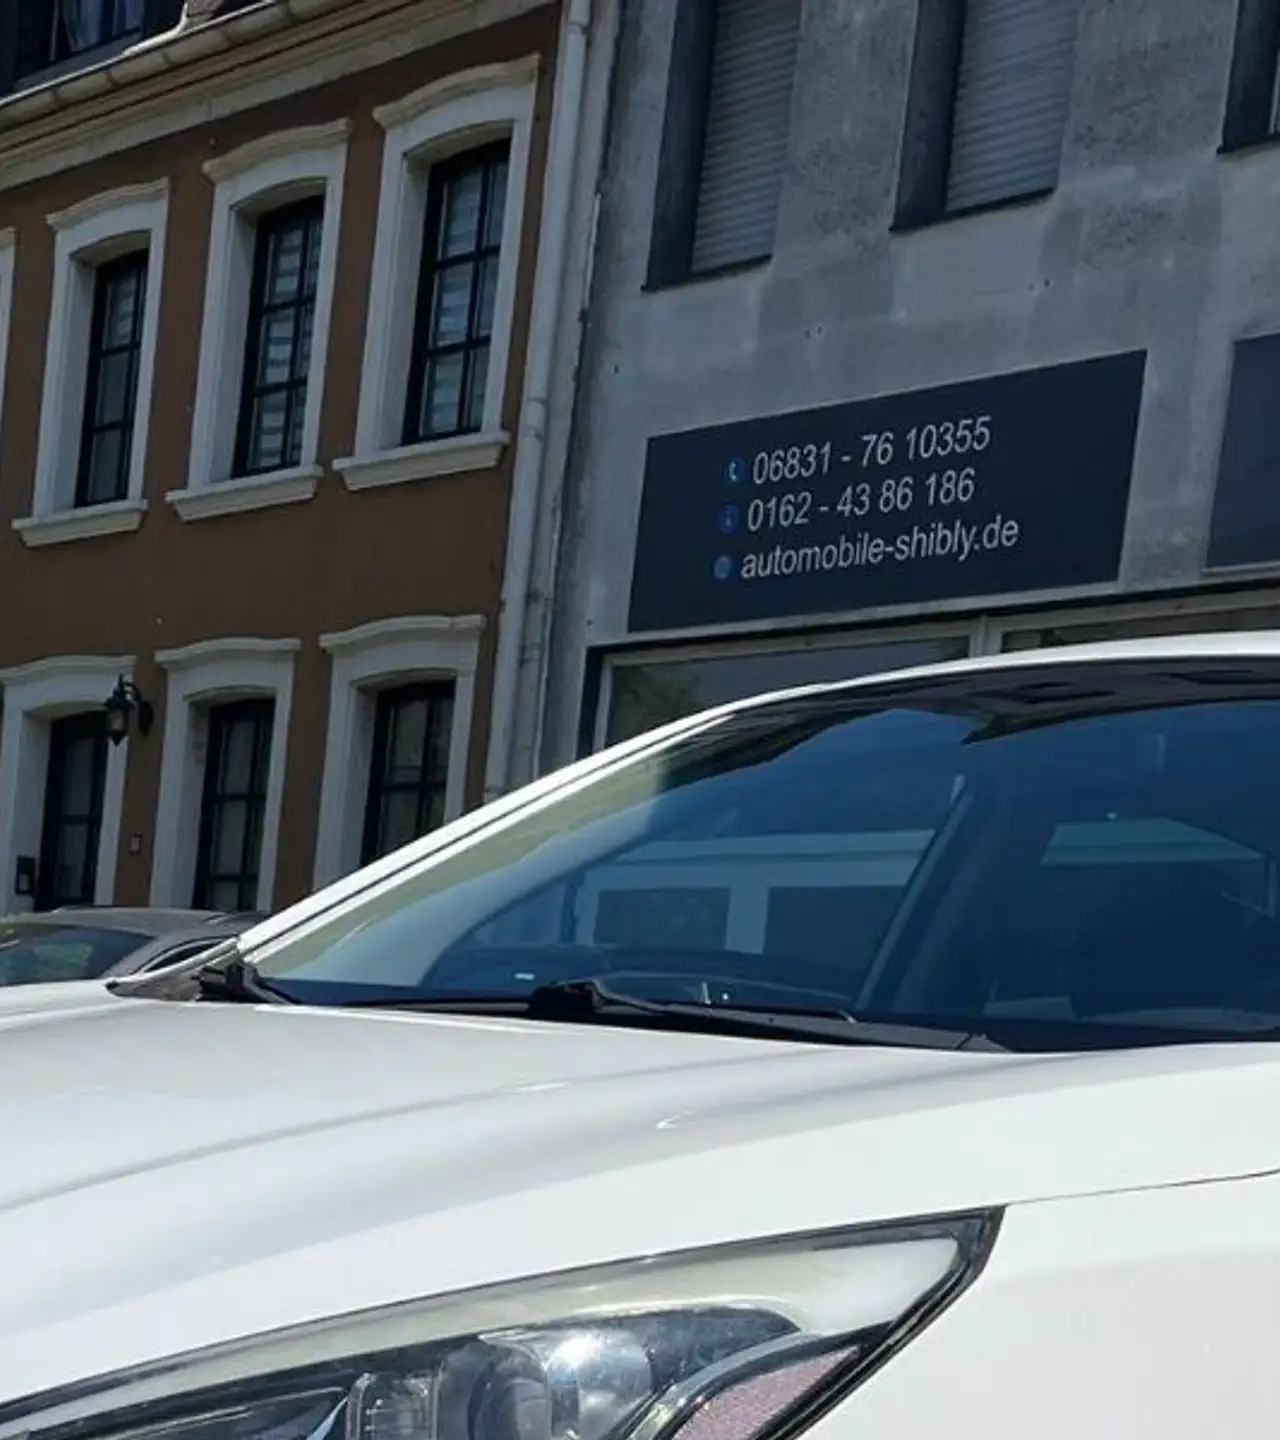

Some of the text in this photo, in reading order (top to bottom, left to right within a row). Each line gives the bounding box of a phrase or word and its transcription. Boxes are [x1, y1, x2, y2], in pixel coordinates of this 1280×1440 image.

[752, 441, 832, 484] 06831
[862, 431, 894, 468] 76
[905, 415, 992, 460] 10355
[747, 491, 812, 532] 0162
[836, 483, 871, 517] 43
[878, 476, 914, 513] 86
[925, 467, 975, 506] 186
[740, 514, 1019, 580] automobile-shibly.de
